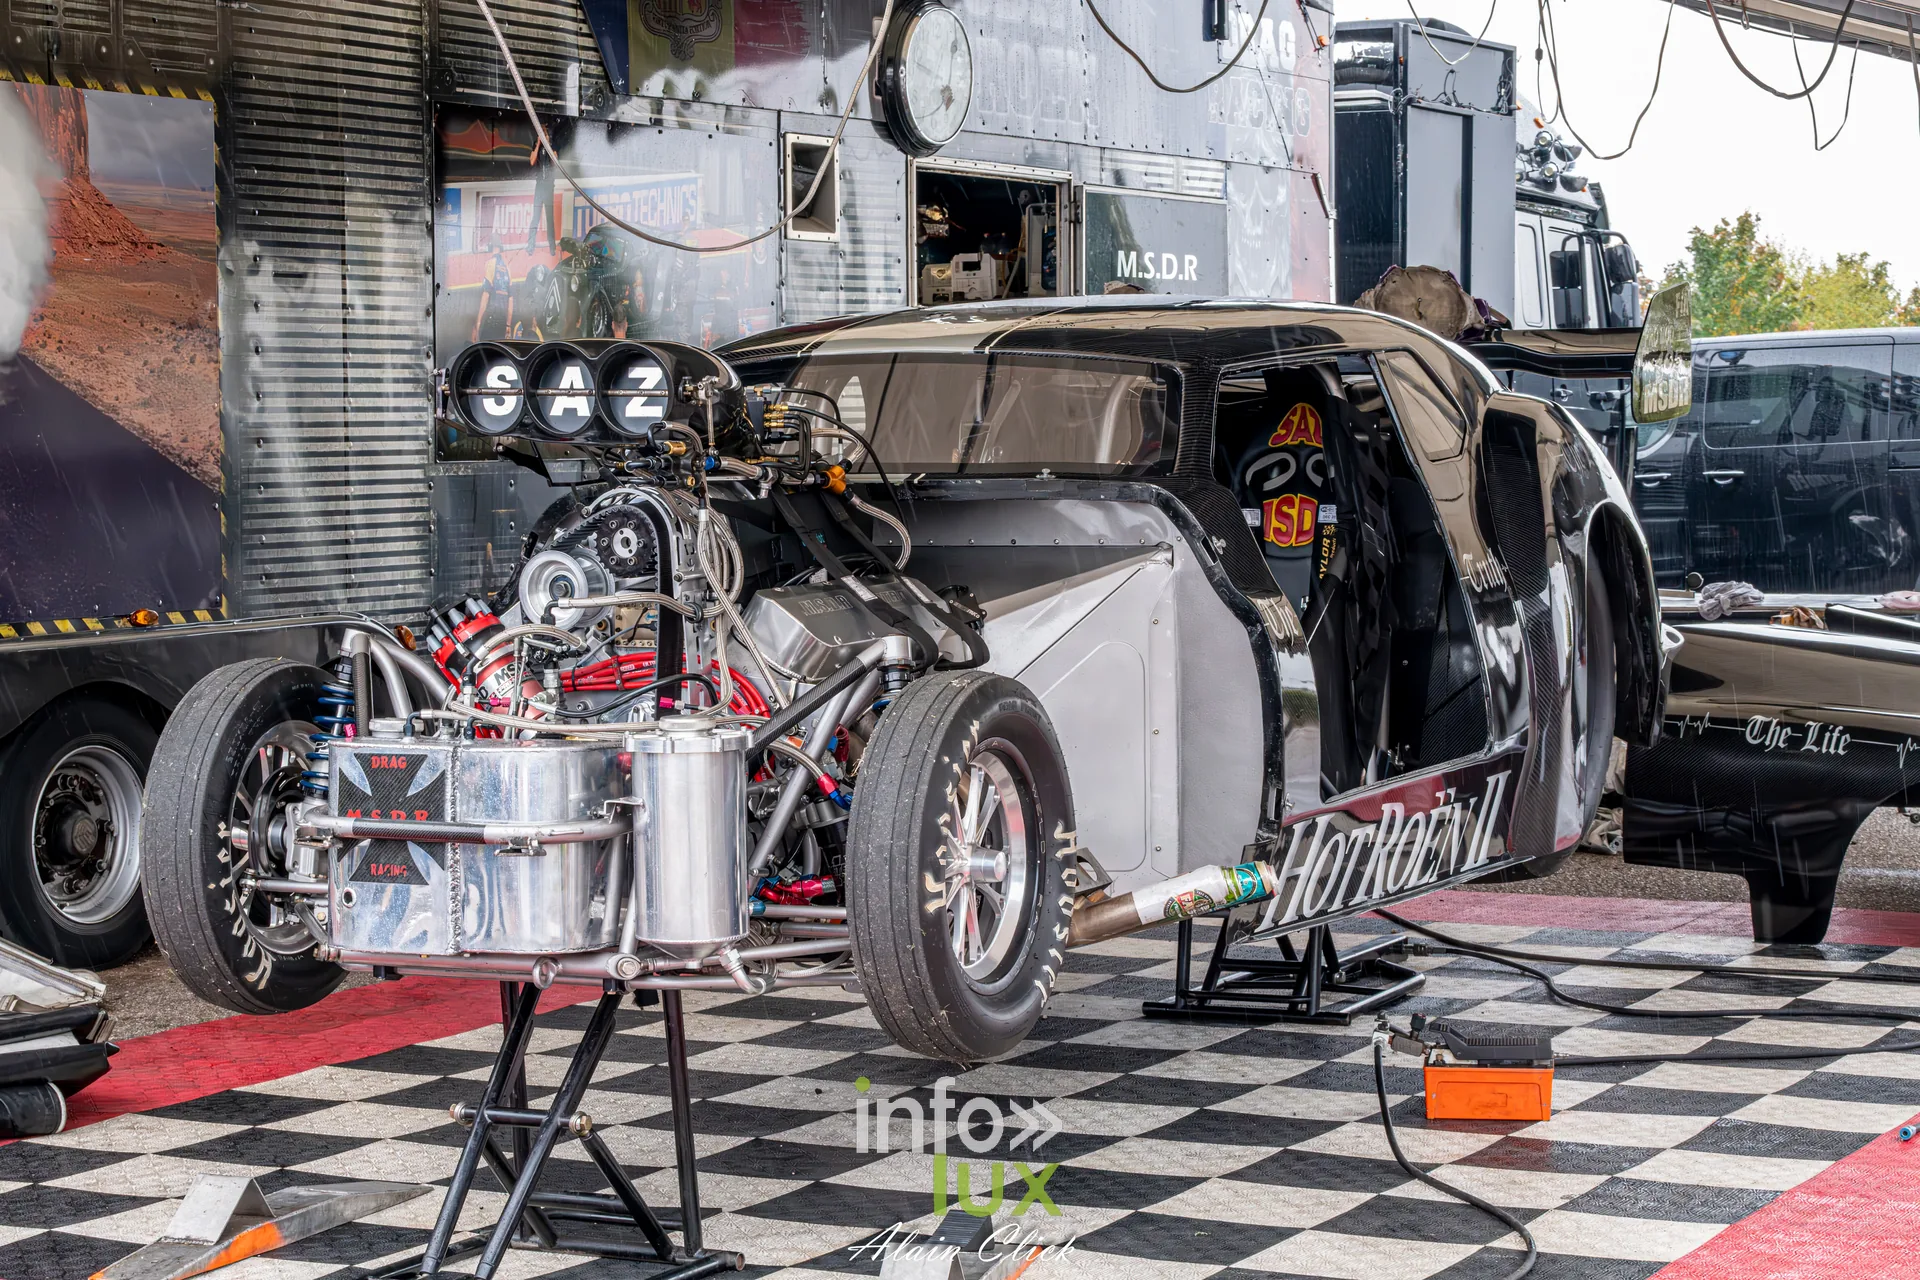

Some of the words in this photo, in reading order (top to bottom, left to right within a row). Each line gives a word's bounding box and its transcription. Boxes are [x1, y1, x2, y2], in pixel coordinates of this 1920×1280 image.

[633, 183, 698, 227] TECHNICS
[1117, 250, 1197, 281] M.S.D.R
[1745, 715, 1792, 752] The
[1800, 721, 1852, 755] Life
[371, 755, 407, 769] DRAG
[370, 863, 407, 877] RACING
